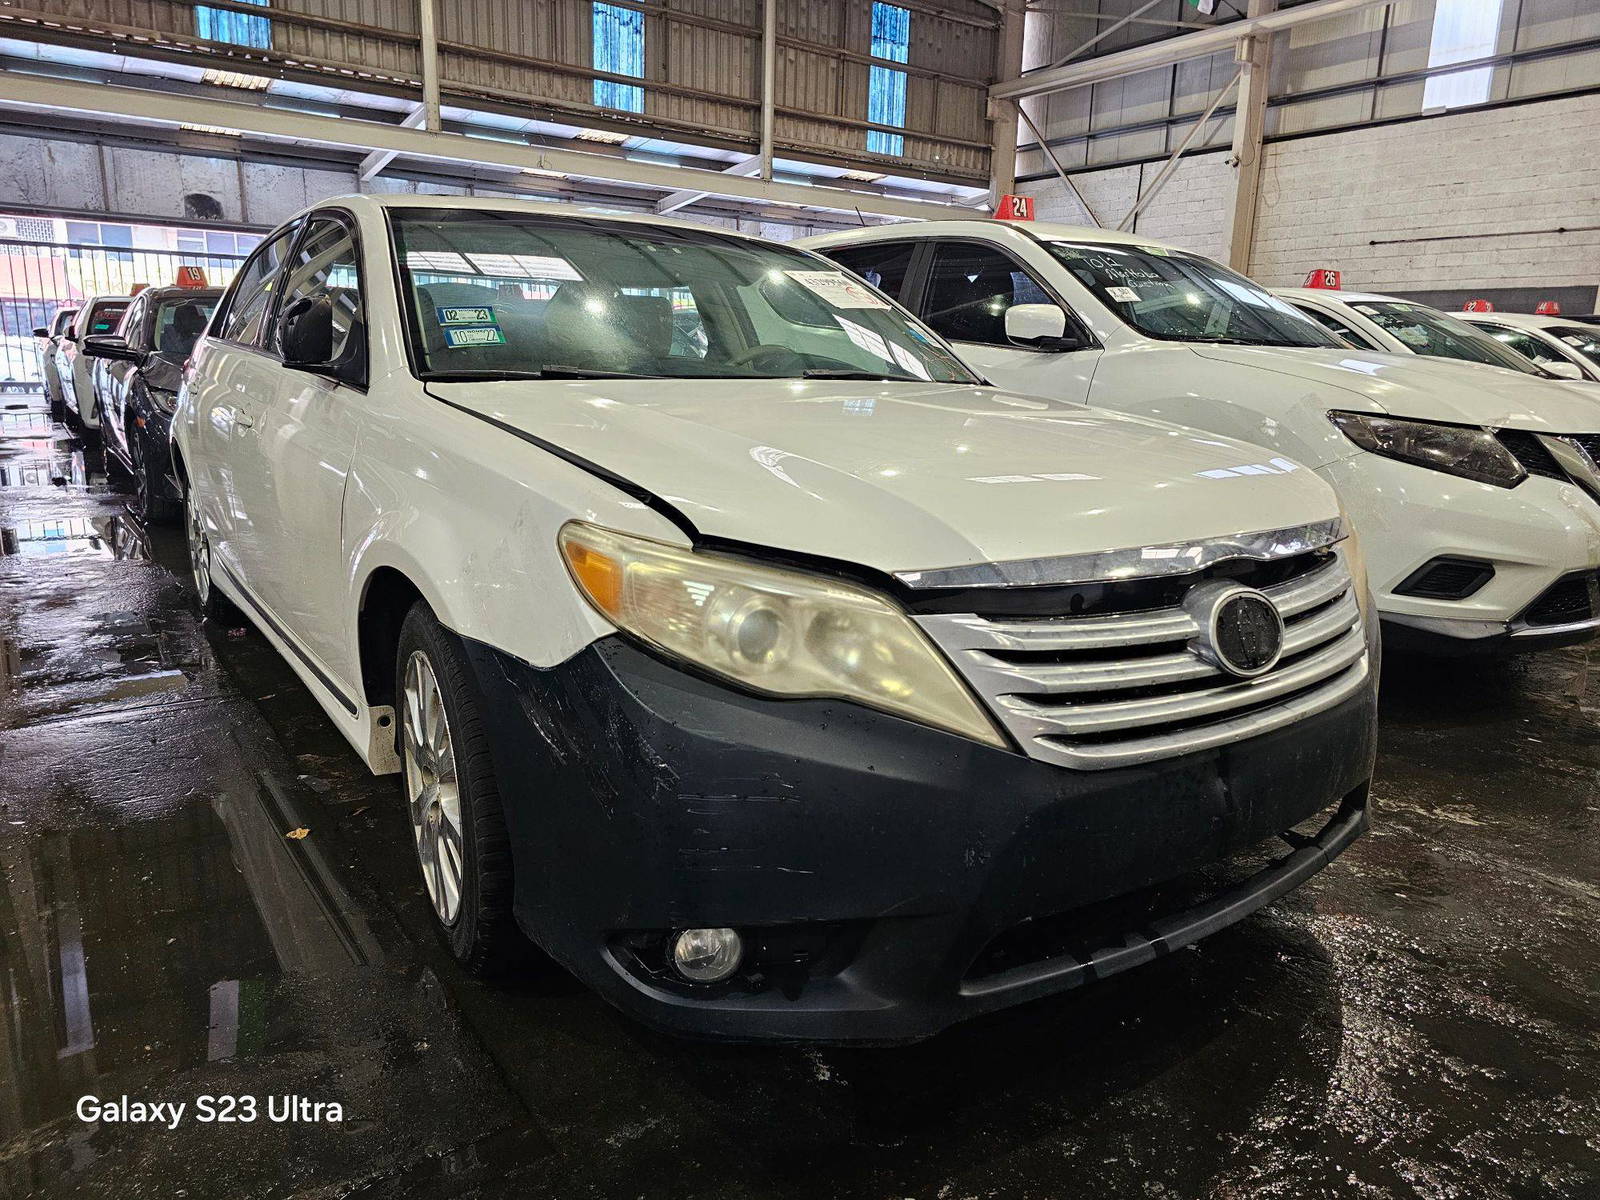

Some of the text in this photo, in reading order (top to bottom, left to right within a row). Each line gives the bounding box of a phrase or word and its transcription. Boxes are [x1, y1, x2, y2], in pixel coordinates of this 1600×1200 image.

[1013, 197, 1027, 217] 24
[187, 267, 201, 281] 19
[1325, 271, 1335, 286] 26
[445, 309, 488, 321] 02 23
[454, 329, 498, 343] 10 22
